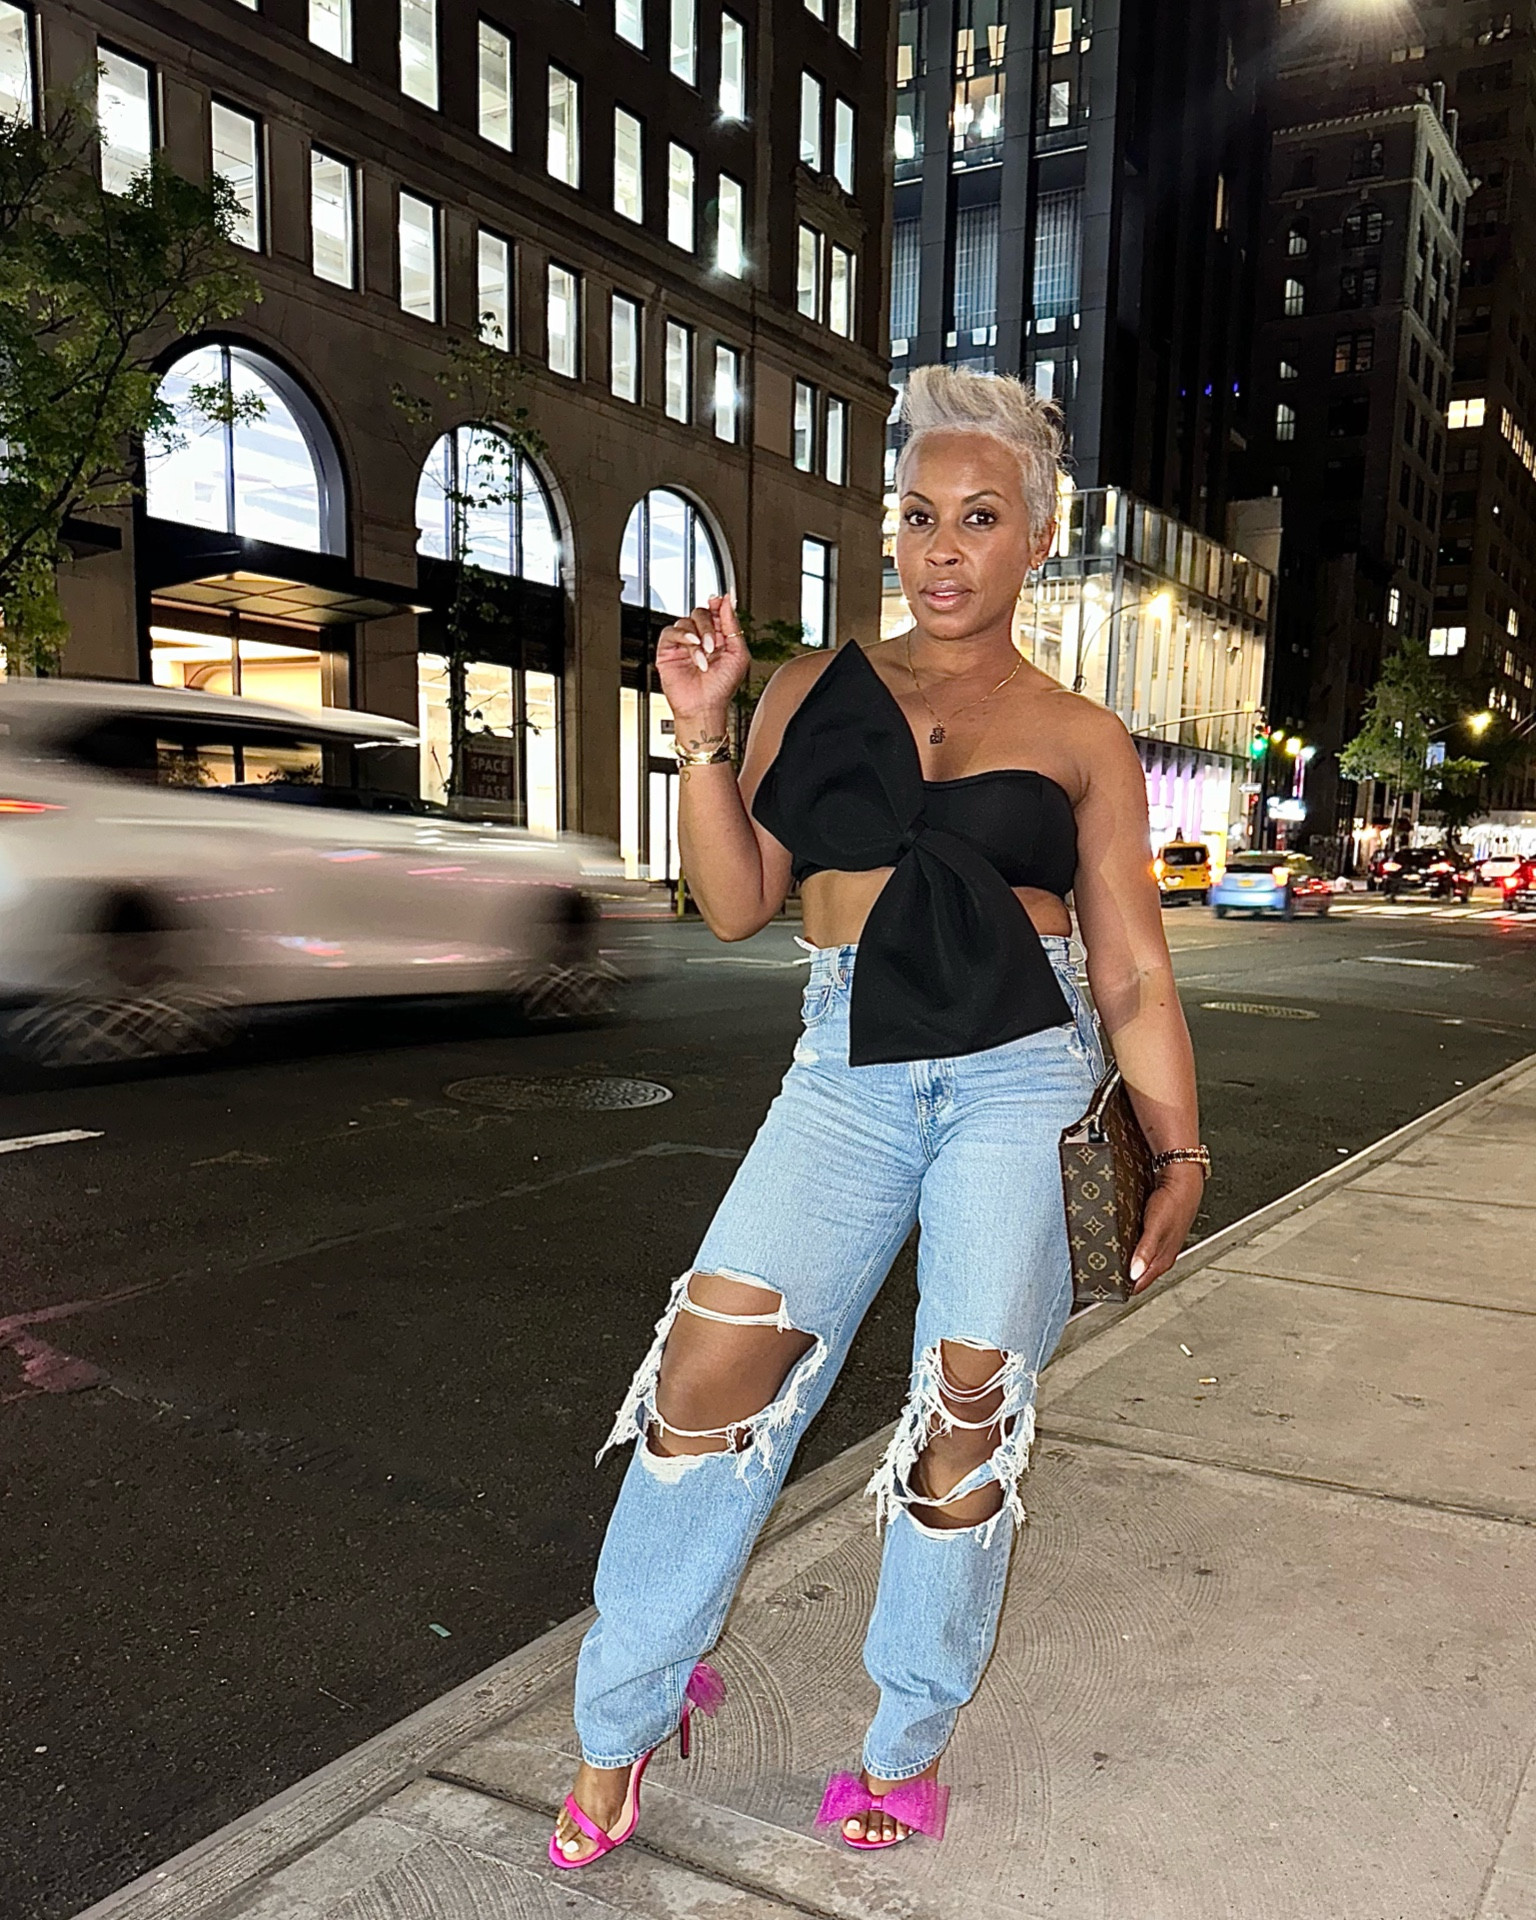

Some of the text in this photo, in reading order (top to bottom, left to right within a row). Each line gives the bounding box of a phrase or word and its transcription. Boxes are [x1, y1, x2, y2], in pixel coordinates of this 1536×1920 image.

[471, 757, 508, 774] SPACE
[482, 774, 497, 783] FOR
[472, 785, 508, 799] LEASE
